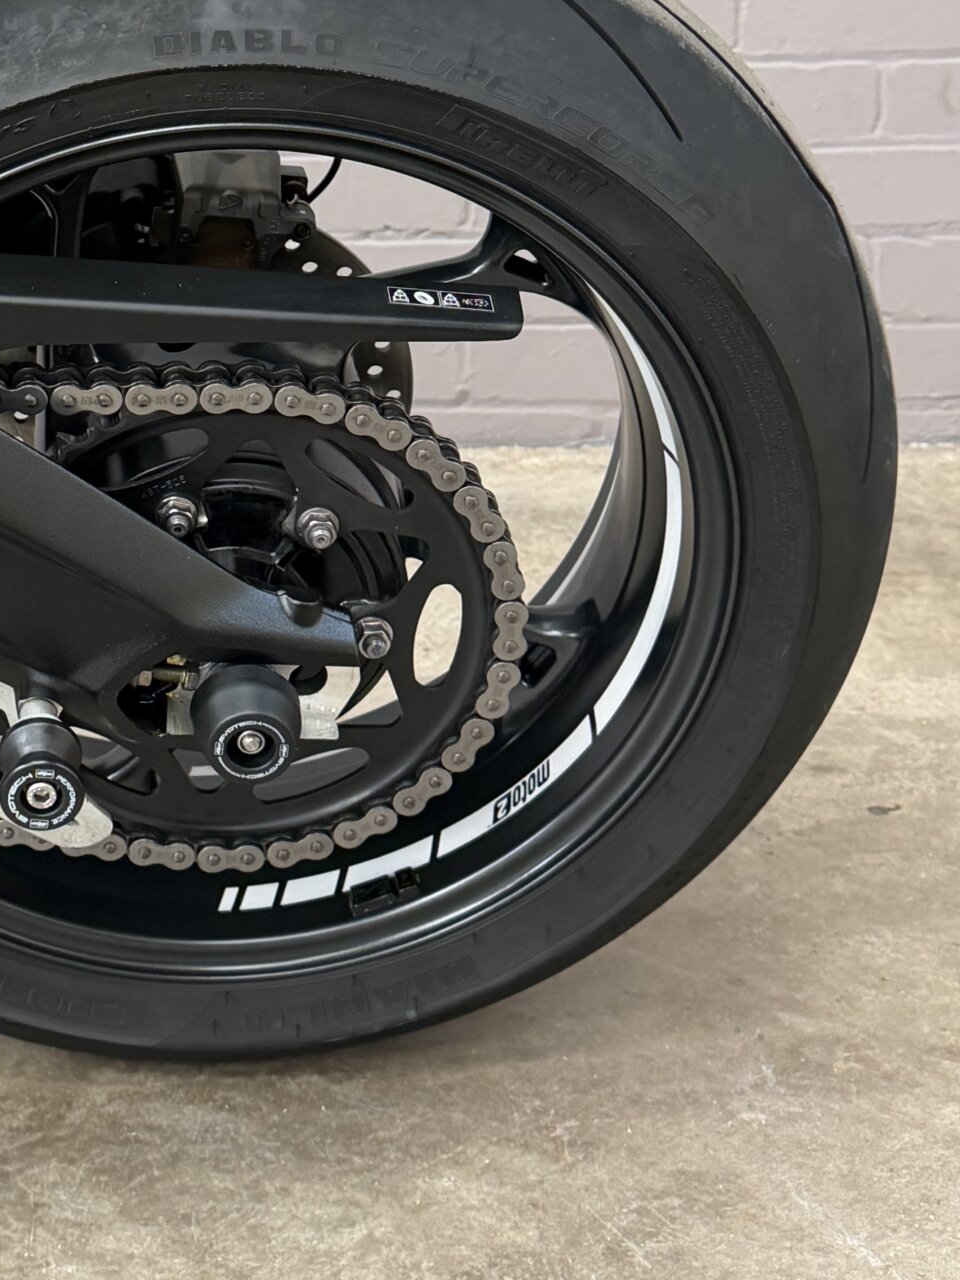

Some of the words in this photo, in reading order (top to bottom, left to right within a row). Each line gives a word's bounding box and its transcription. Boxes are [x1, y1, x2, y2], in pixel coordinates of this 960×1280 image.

[153, 29, 344, 57] DIABLO
[7, 772, 34, 824] EVOTECH
[51, 774, 77, 825] PERFORMANCE
[492, 758, 551, 825] moto2
